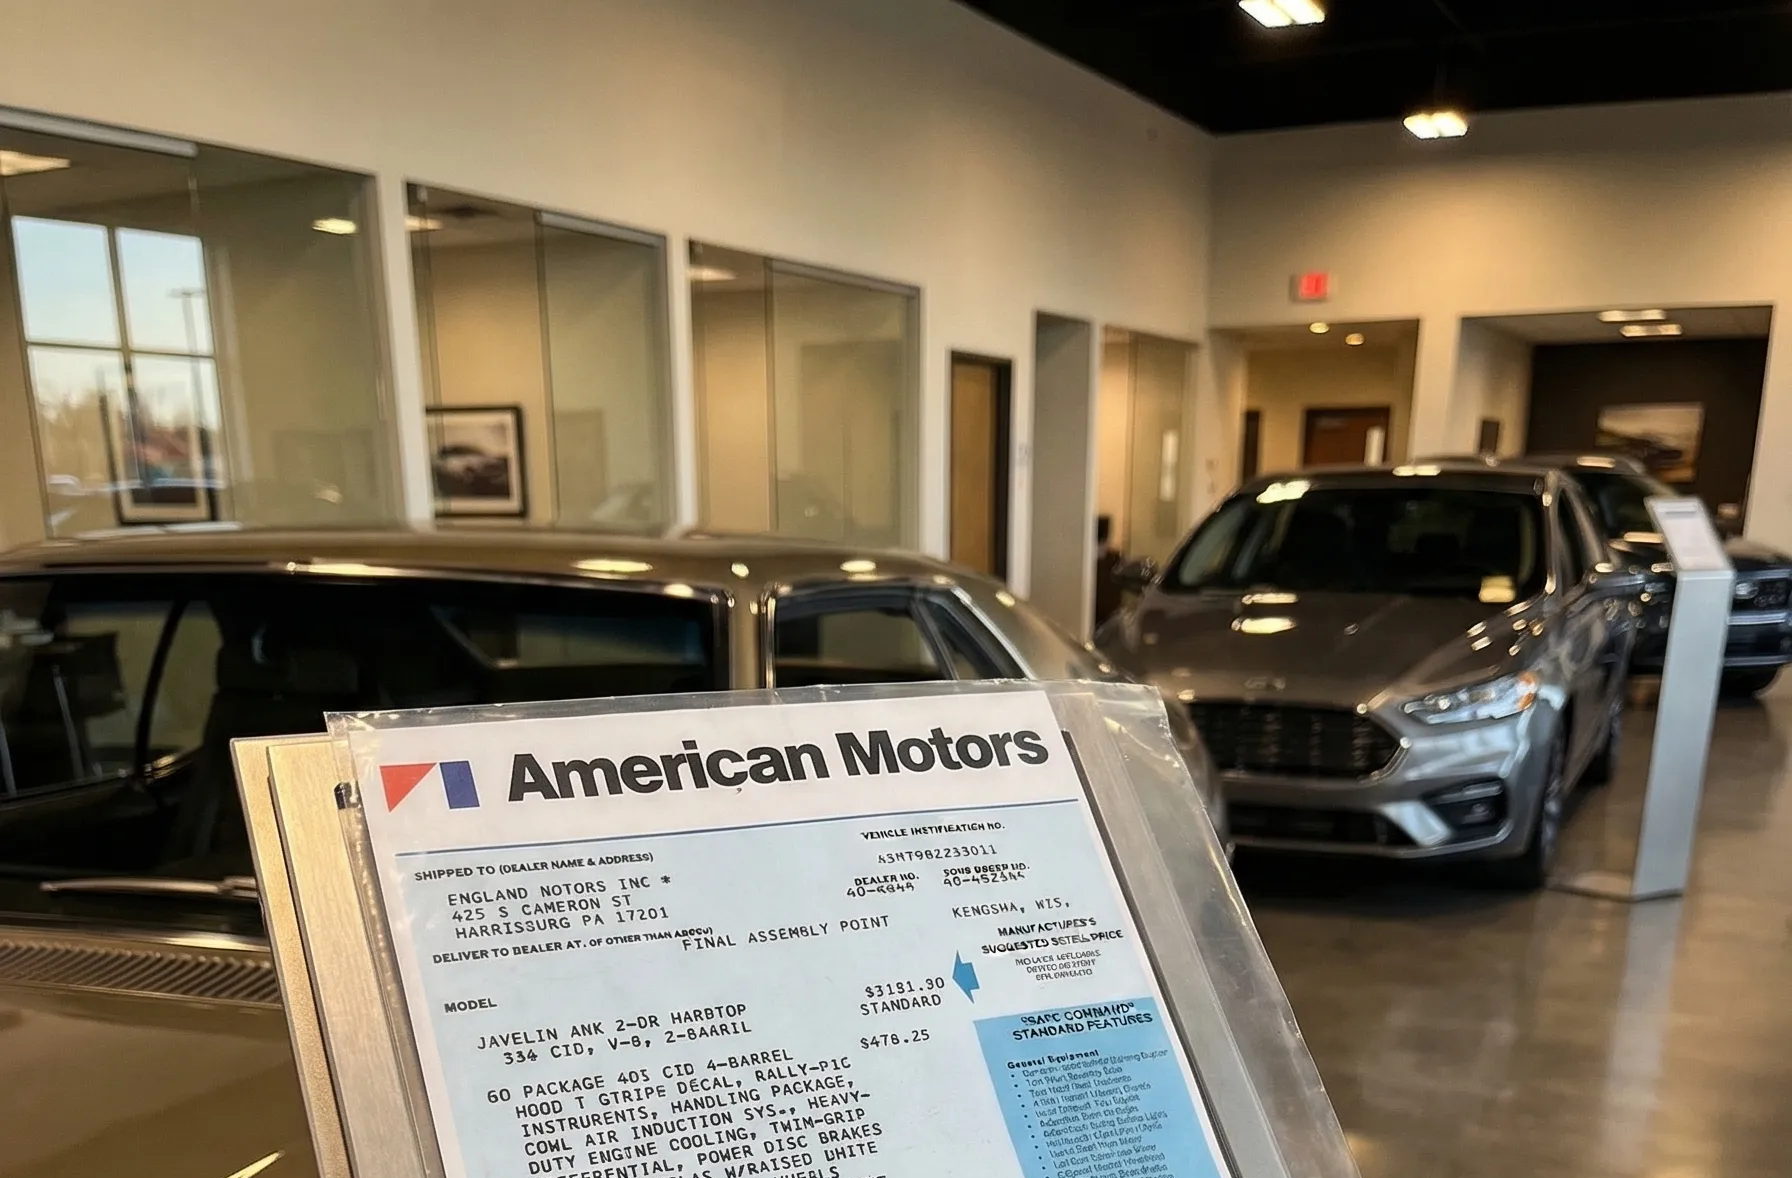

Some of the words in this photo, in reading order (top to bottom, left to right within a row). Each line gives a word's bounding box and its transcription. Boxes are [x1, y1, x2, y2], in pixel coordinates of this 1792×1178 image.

[507, 739, 831, 803] American
[834, 726, 1050, 777] Motors
[414, 867, 474, 882] SHIPPED
[475, 865, 496, 876] TO
[550, 858, 586, 870] NAME
[447, 887, 529, 907] ENGLAND
[617, 876, 651, 891] INC
[451, 907, 486, 923] 425
[497, 905, 509, 919] S
[521, 897, 601, 916] CAMERON
[611, 893, 631, 908] ST
[581, 913, 605, 927] PA
[615, 906, 669, 923] 17201
[839, 914, 889, 933] POINT
[432, 949, 490, 964] DELIVER
[490, 947, 510, 958] TO
[588, 937, 603, 947] OF
[443, 997, 498, 1014] MODEL
[859, 993, 942, 1016] STANDARD
[477, 1027, 559, 1050] JAVELIN
[570, 1021, 605, 1039] ANK
[615, 1014, 661, 1032] 2-DR
[549, 1042, 594, 1059] CID,
[487, 1088, 511, 1104] 60
[522, 1075, 605, 1099] PACKAGE
[662, 1062, 695, 1079] CID
[706, 1048, 794, 1072] 4-BARREL
[515, 1099, 563, 1119] HOOD
[574, 1095, 585, 1110] T
[670, 1088, 761, 1115] HANDLING
[770, 1074, 854, 1098] PACKAGE,
[585, 1129, 620, 1147] AIR
[630, 1110, 734, 1141] INDUCTION
[528, 1154, 576, 1175] DUTY
[668, 1126, 757, 1152] COOLING,
[696, 1144, 755, 1166] POWER
[763, 1134, 808, 1154] DISC
[817, 1122, 883, 1145] BRAKES
